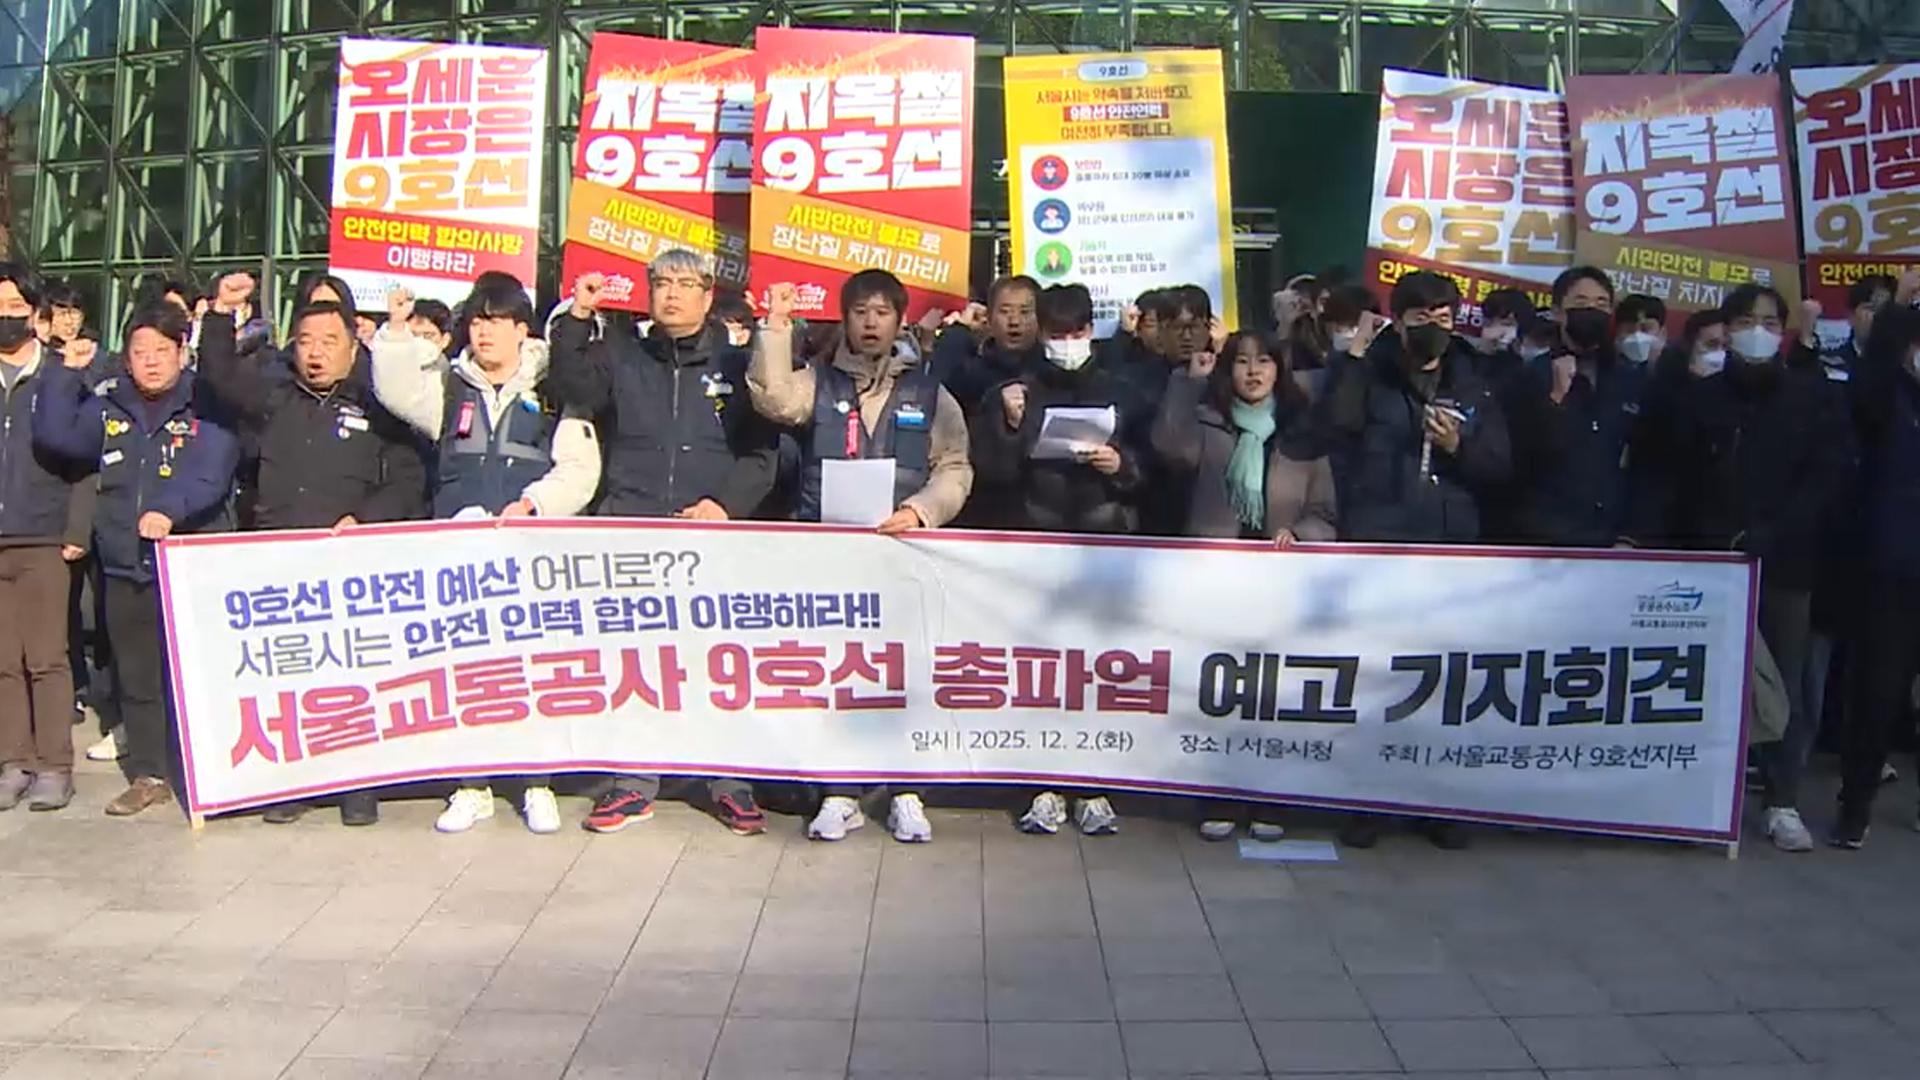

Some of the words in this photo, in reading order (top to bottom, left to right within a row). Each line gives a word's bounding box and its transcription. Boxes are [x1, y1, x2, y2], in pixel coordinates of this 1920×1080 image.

[350, 56, 536, 108] 오세훈
[1036, 88, 1089, 104] 서울시는
[1099, 66, 1130, 77] 9호선
[764, 70, 962, 132] 지옥철
[1069, 105, 1106, 121] 9호선
[1108, 103, 1162, 119] 안전인력
[1390, 94, 1570, 151] 오세훈
[346, 106, 532, 159] 시장은
[1061, 123, 1101, 140] 여전히
[1581, 106, 1778, 176] 지옥철
[343, 157, 529, 211] 9호선
[761, 130, 963, 194] 9호선
[1385, 148, 1576, 206] 시장은
[603, 199, 687, 237] 시민안전
[1585, 164, 1785, 234] 9호선
[343, 217, 432, 246] 안전인력
[436, 226, 524, 255] 합의사항
[587, 216, 653, 256] 장난질
[772, 225, 842, 259] 장난질
[846, 242, 890, 270] 치지
[895, 252, 951, 284] 마라!
[787, 203, 875, 239] 시민안전
[877, 224, 942, 255] 볼모로
[1380, 203, 1576, 266] 9호선
[386, 249, 476, 275] 이행하라
[1605, 268, 1673, 299] 장난질
[1616, 247, 1702, 278] 시민안전
[225, 582, 331, 630] 9호선
[342, 571, 426, 616] 안전
[436, 557, 521, 606] 예산
[531, 551, 700, 592] 어디로??
[235, 627, 392, 677] 서울시는
[402, 607, 489, 657] 안전
[500, 597, 583, 640] 인력
[594, 596, 678, 635] 합의
[691, 593, 881, 632] 이행해라!!
[231, 644, 685, 766] 서울교통공사
[707, 640, 906, 711] 9호선
[932, 642, 1171, 714] 총파업
[1199, 650, 1359, 723] 예고
[1384, 644, 1705, 727] 기자회견
[911, 728, 950, 752] 일시
[968, 729, 1034, 751] 2025.
[1041, 731, 1070, 751] 12.
[1076, 730, 1134, 753] 2.(화)
[1179, 733, 1218, 756] 장소
[1238, 736, 1333, 762] 서울시청
[1379, 742, 1421, 765] 주최
[1439, 745, 1582, 770] 서울교통공사
[1590, 743, 1699, 771] 9호선지부
